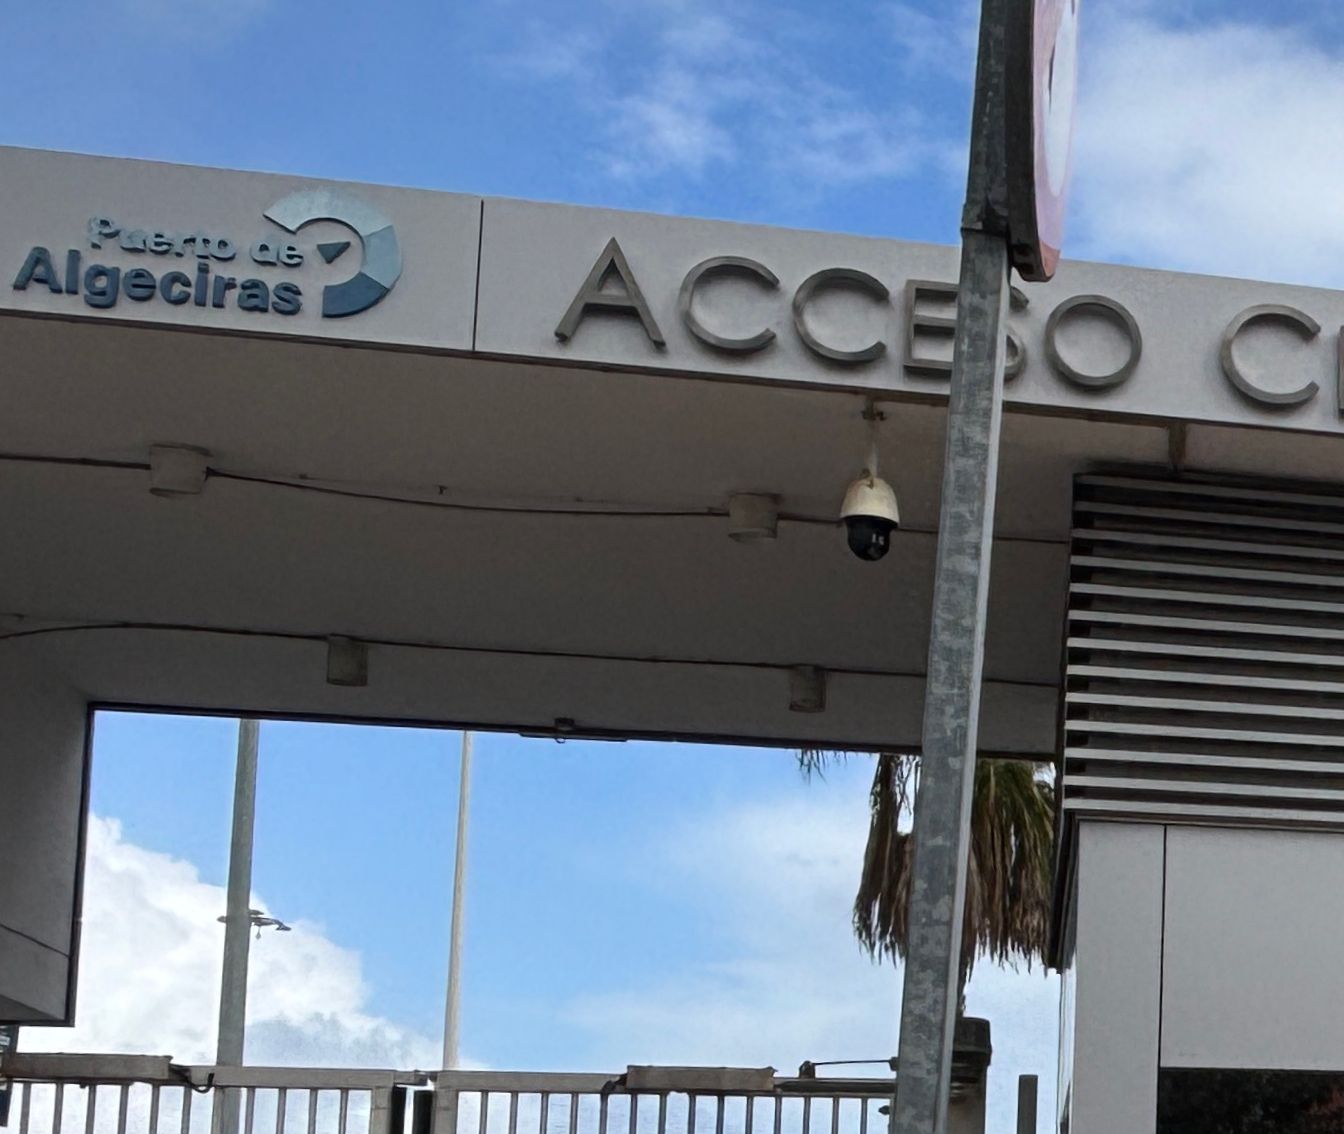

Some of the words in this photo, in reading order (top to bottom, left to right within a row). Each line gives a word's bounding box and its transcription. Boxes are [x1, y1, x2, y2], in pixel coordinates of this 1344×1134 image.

[91, 217, 236, 259] Puerto
[250, 235, 303, 266] de
[13, 246, 302, 315] Algeciras
